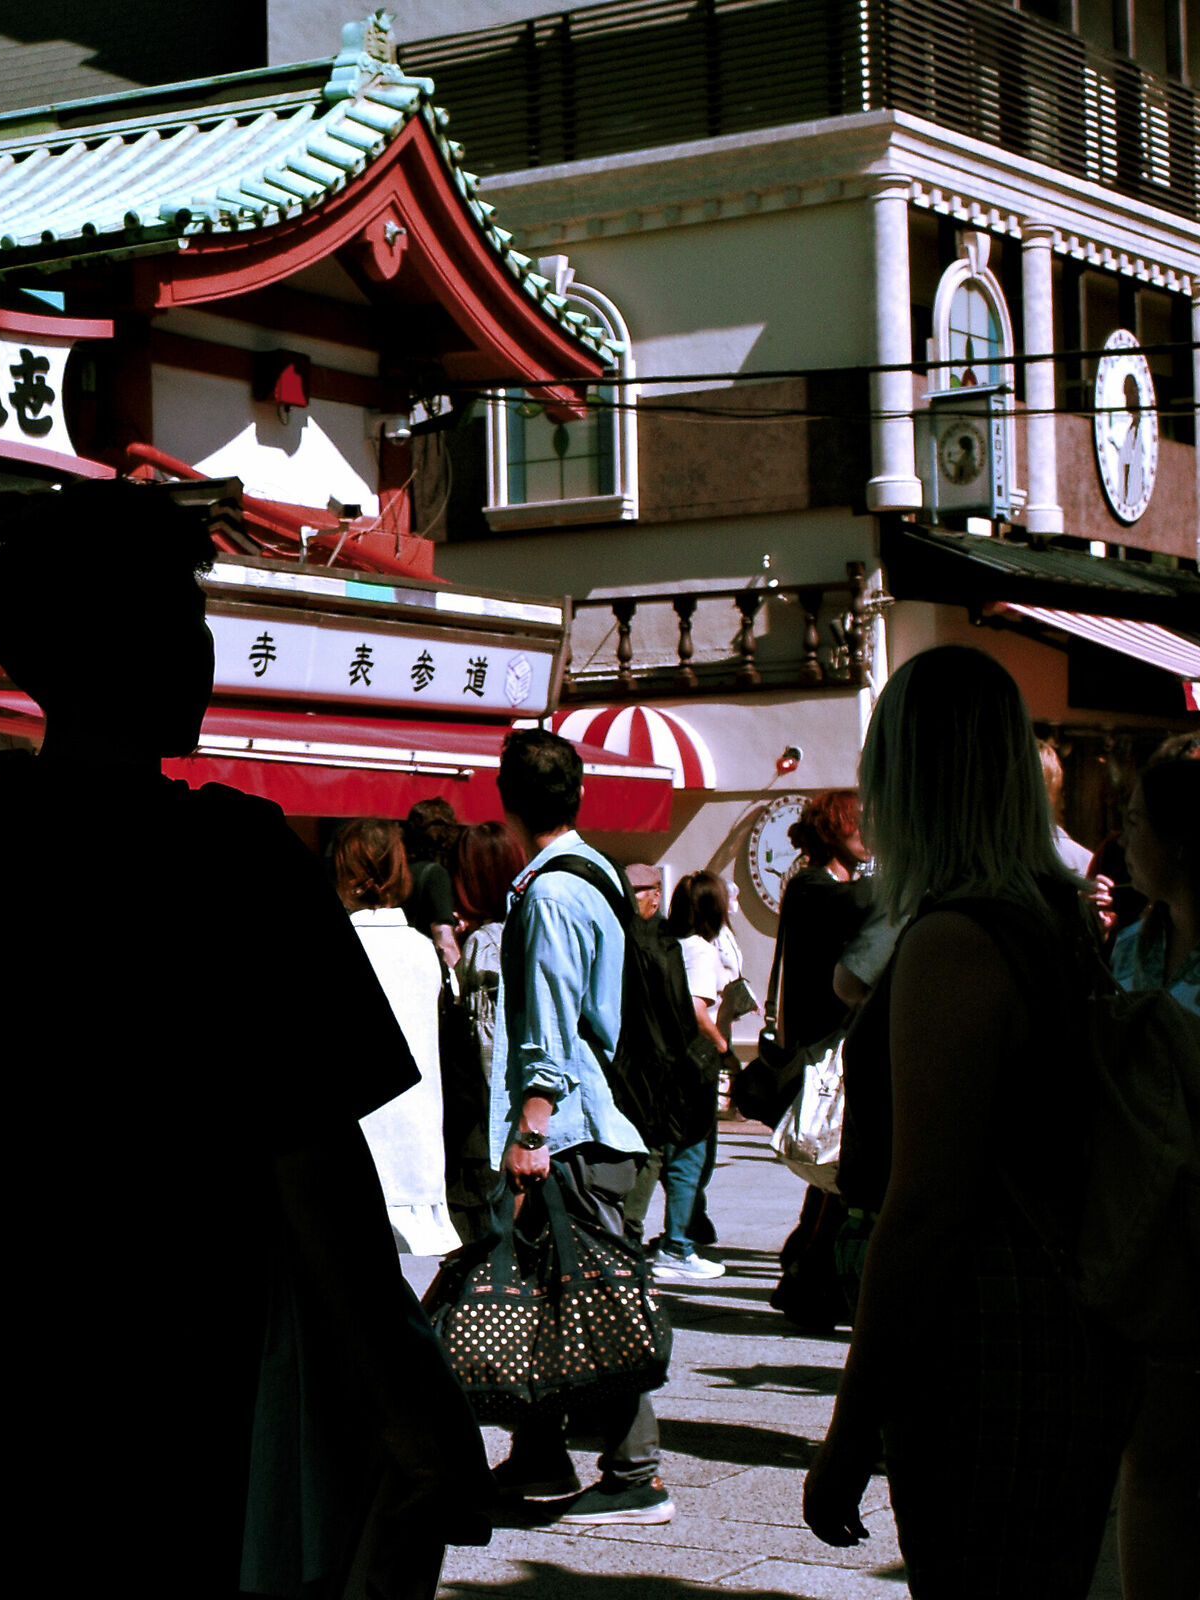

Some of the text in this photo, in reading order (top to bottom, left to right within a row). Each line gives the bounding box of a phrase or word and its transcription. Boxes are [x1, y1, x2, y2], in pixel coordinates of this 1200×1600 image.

[248, 631, 489, 698] 寺 表参道
